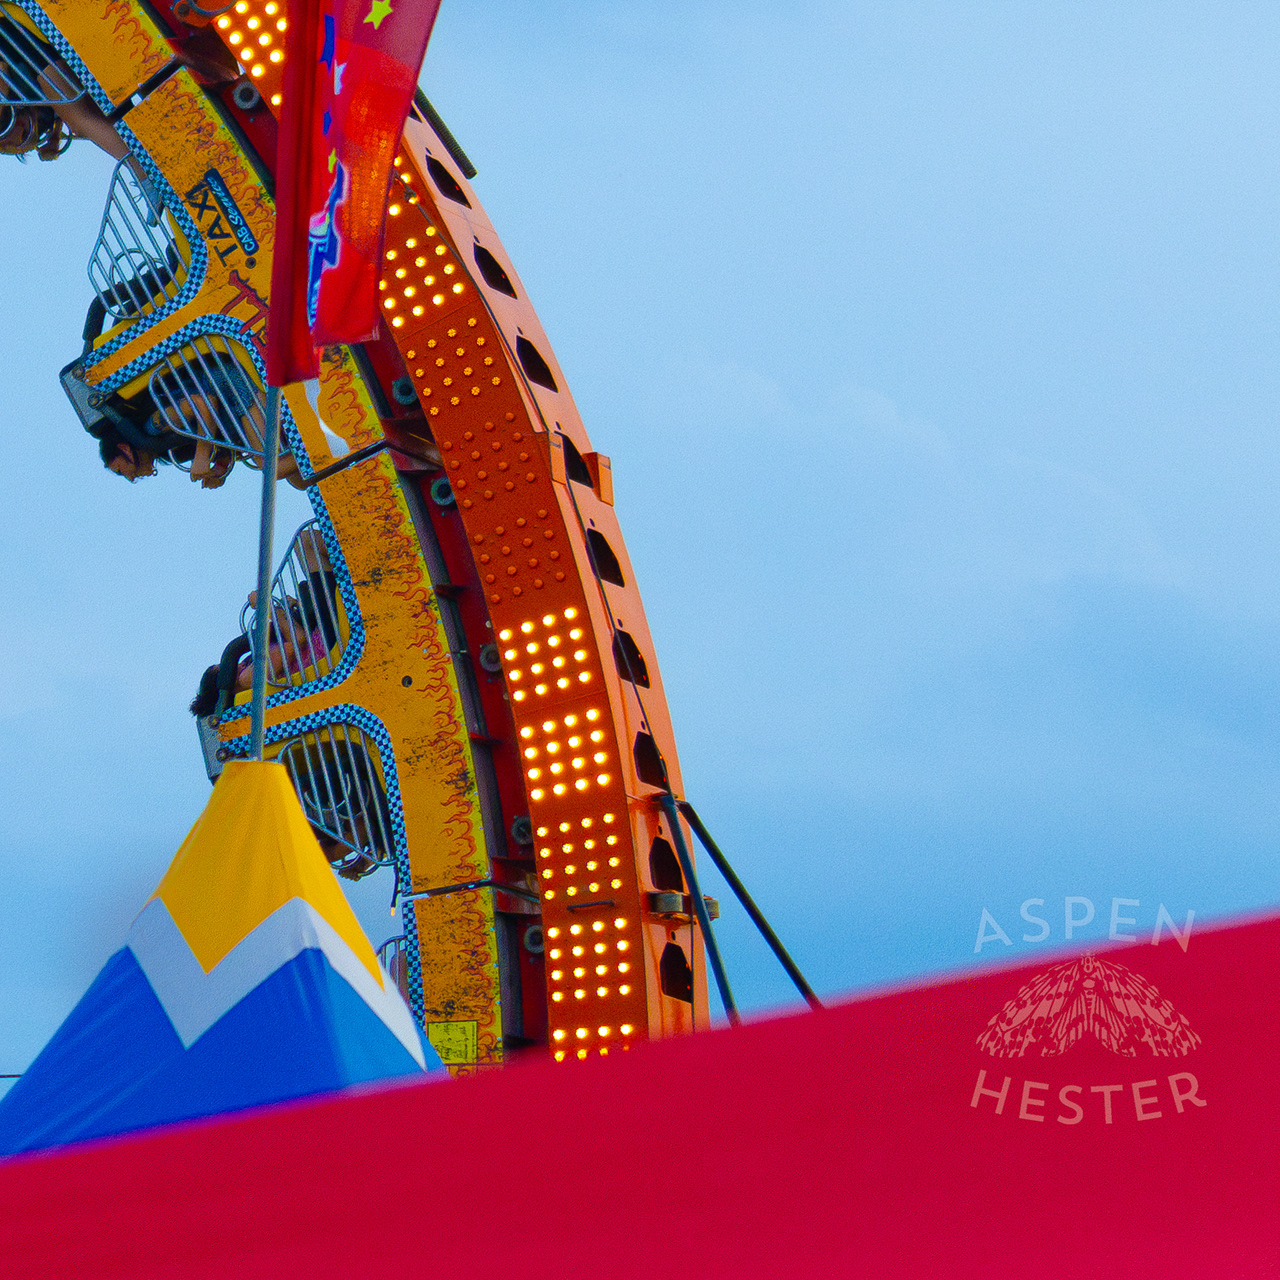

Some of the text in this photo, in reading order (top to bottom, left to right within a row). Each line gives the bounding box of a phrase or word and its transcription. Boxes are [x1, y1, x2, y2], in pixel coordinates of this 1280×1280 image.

[185, 181, 238, 267] TAXI
[207, 176, 241, 226] Service
[237, 224, 255, 252] CAB
